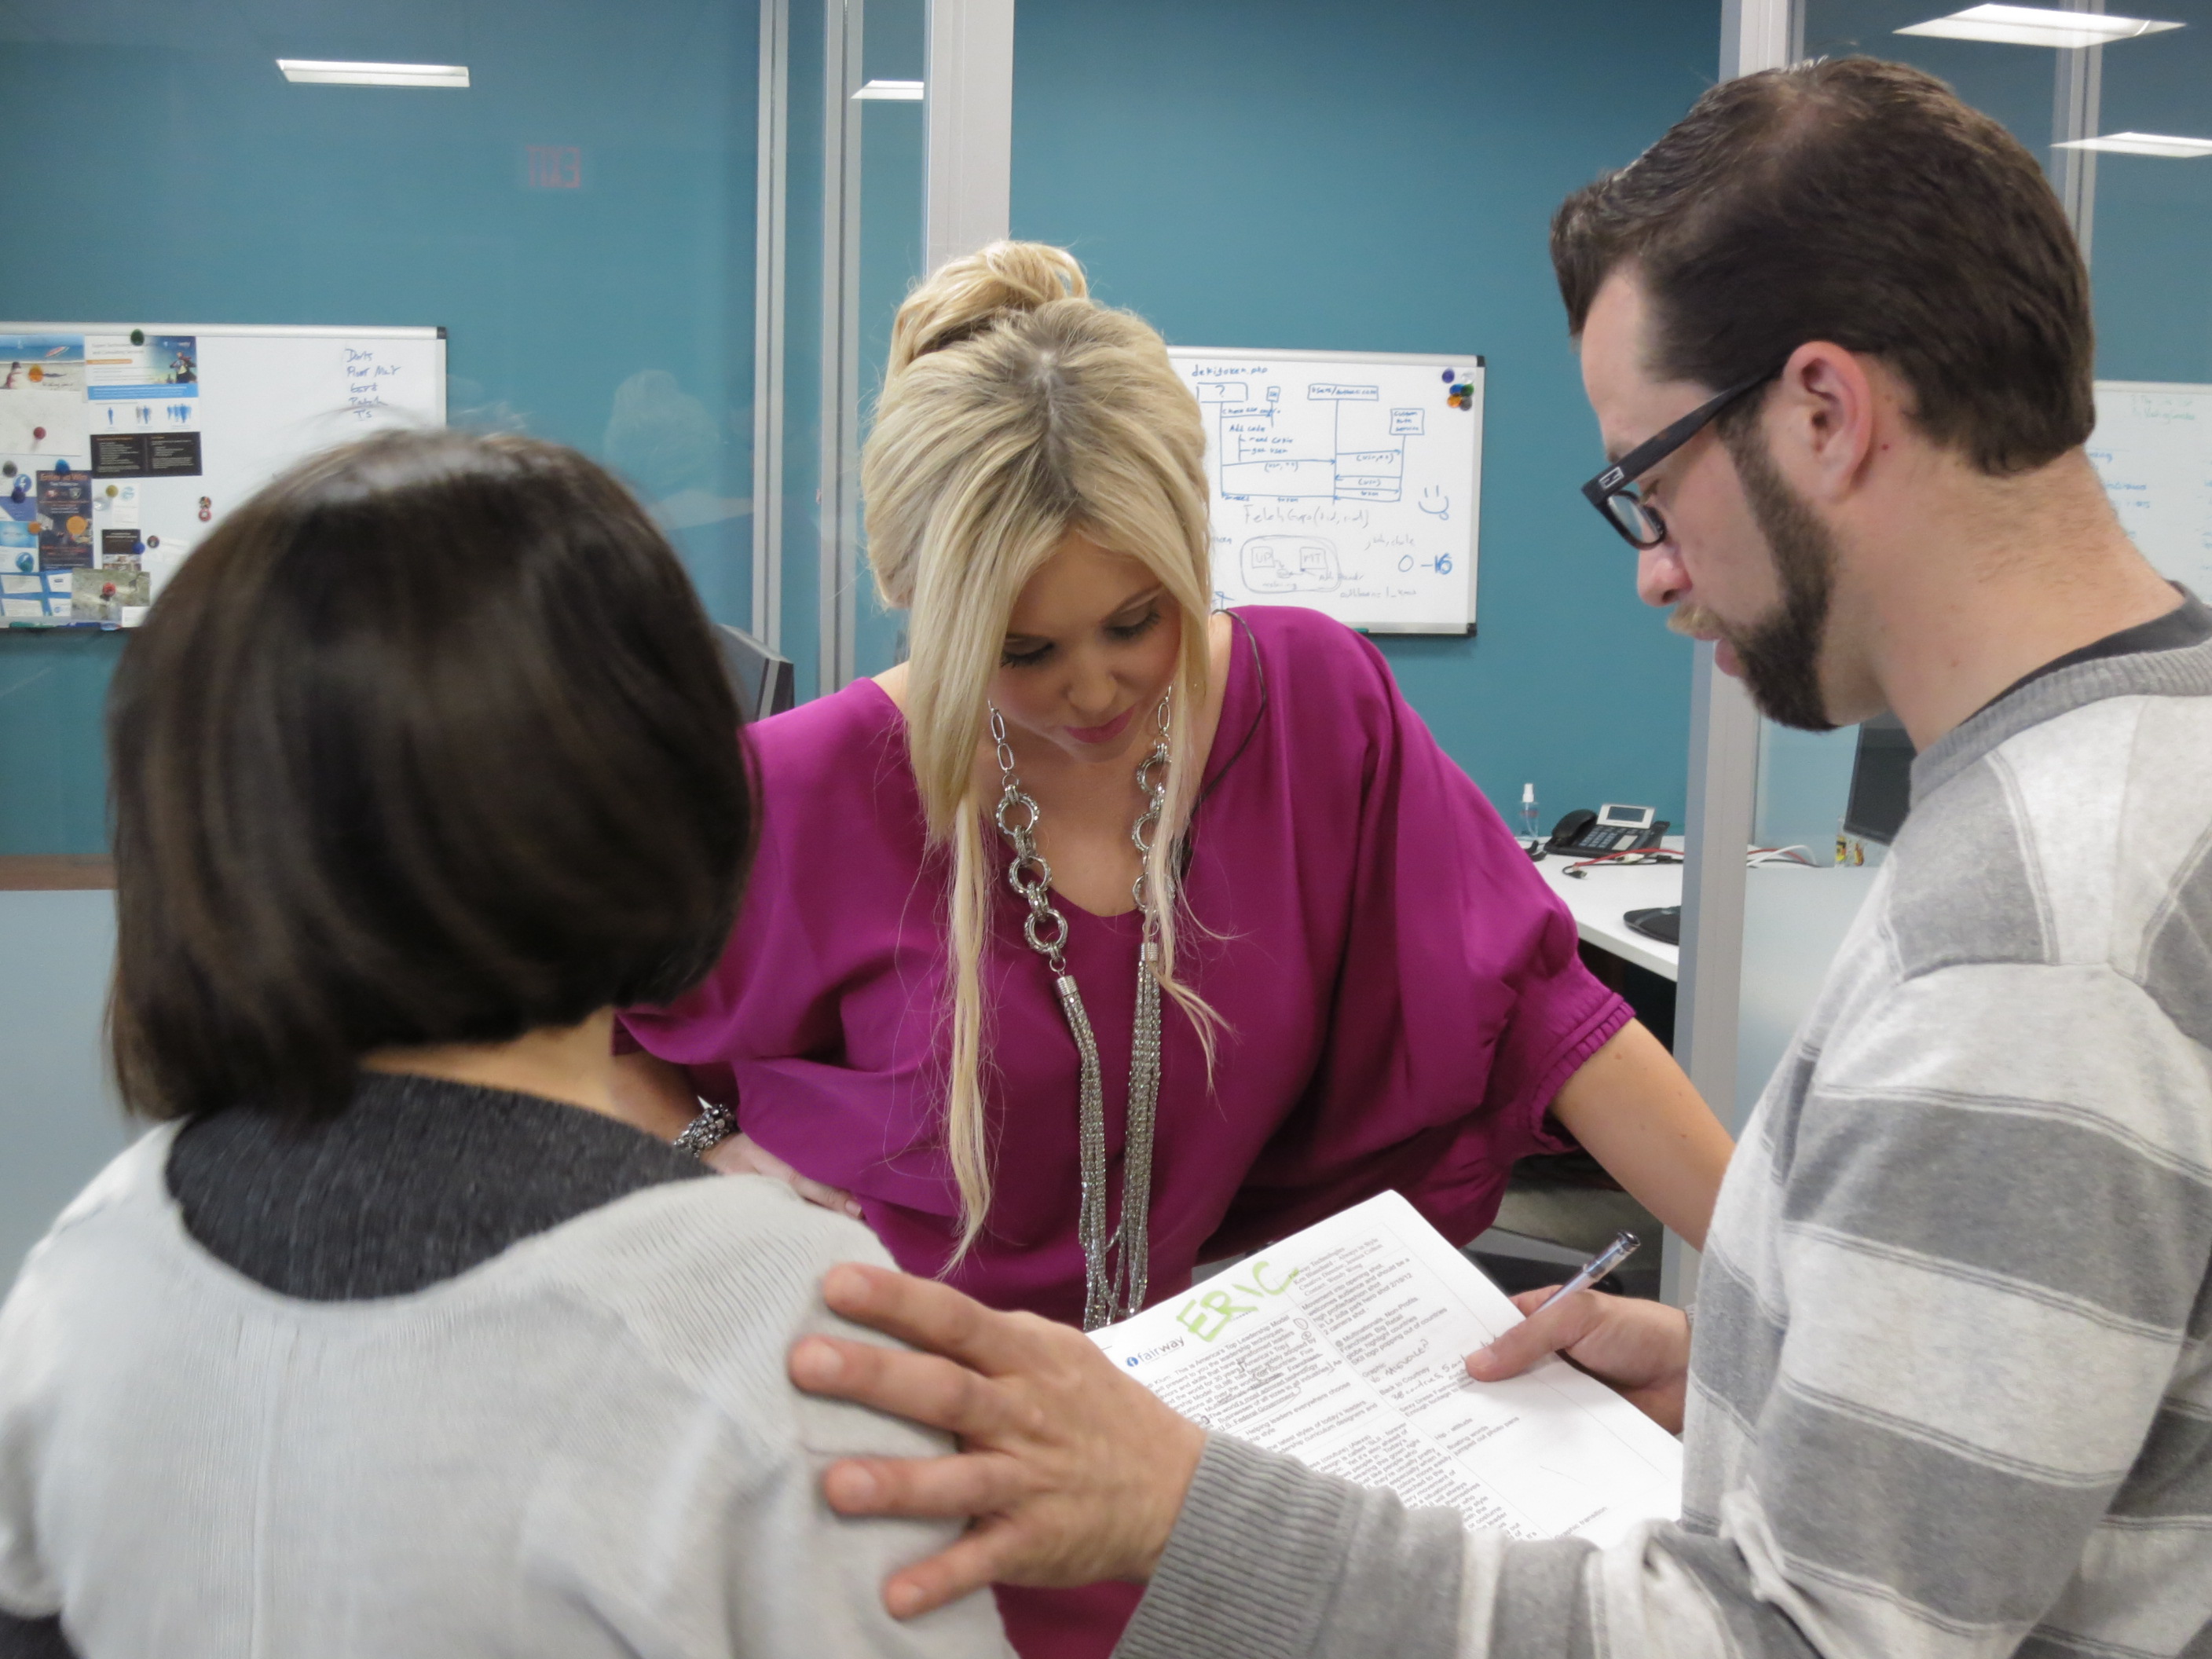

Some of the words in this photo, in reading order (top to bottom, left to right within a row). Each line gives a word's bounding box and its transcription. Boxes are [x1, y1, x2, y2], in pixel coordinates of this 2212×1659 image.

[1305, 1261, 1334, 1279] Blanchard
[1176, 1260, 1299, 1342] ERIC
[1301, 1290, 1335, 1311] Movement
[1333, 1284, 1346, 1293] into
[1345, 1271, 1371, 1287] opening
[1307, 1298, 1338, 1317] welcomes
[1338, 1282, 1365, 1300] audience
[1376, 1264, 1397, 1278] should
[1312, 1313, 1328, 1323] high
[1367, 1281, 1382, 1292] shot
[1335, 1309, 1350, 1320] Jolla
[1348, 1301, 1364, 1313] park
[1361, 1293, 1377, 1304] hero
[1376, 1284, 1391, 1295] shot
[1329, 1317, 1353, 1332] camera
[1352, 1308, 1367, 1320] shot
[1364, 1331, 1390, 1349] highlight
[1390, 1316, 1418, 1334] countries
[1364, 1347, 1379, 1358] logo
[1379, 1333, 1404, 1351] popping
[1420, 1307, 1448, 1325] countries
[1384, 1313, 1404, 1327] Retail
[1137, 1335, 1185, 1364] fairway
[1165, 1375, 1189, 1390] present
[1218, 1344, 1251, 1363] leadership
[1251, 1328, 1284, 1346] techniques
[1174, 1367, 1189, 1375] This
[1195, 1348, 1226, 1366] America's
[1236, 1325, 1272, 1345] Leadership
[1269, 1314, 1291, 1328] Model
[1191, 1375, 1207, 1385] skills
[1207, 1368, 1221, 1377] that
[1219, 1361, 1236, 1371] have
[1271, 1331, 1295, 1345] leaders
[1242, 1350, 1274, 1368] America's
[1246, 1364, 1264, 1375] been
[1283, 1340, 1308, 1357] adopted
[1362, 1362, 1386, 1378] Graphic
[1379, 1385, 1396, 1396] Back
[1401, 1366, 1430, 1383] Courtney
[1187, 1384, 1205, 1396] world
[1404, 1403, 1430, 1418] Enough
[1427, 1391, 1452, 1405] footage
[1414, 1393, 1434, 1404] Dress
[1432, 1381, 1459, 1395] Fashion
[1244, 1421, 1271, 1436] Helping
[1269, 1410, 1294, 1424] leaders
[1293, 1393, 1329, 1413] everywhere
[1328, 1382, 1351, 1395] choose
[1277, 1434, 1296, 1446] latest
[1295, 1426, 1315, 1437] styles
[1320, 1412, 1344, 1425] today's
[1342, 1400, 1367, 1414] leaders
[1304, 1423, 1337, 1442] curriculum
[1335, 1409, 1366, 1426] designers
[1450, 1418, 1474, 1432] attitude
[1260, 1427, 1276, 1437] style
[1446, 1436, 1471, 1451] floating
[1469, 1426, 1489, 1437] words
[1453, 1440, 1477, 1457] jumped
[1485, 1425, 1505, 1437] photo
[1352, 1464, 1379, 1481] wearing
[1375, 1457, 1390, 1467] this
[1388, 1447, 1406, 1460] gown
[1405, 1438, 1421, 1449] right
